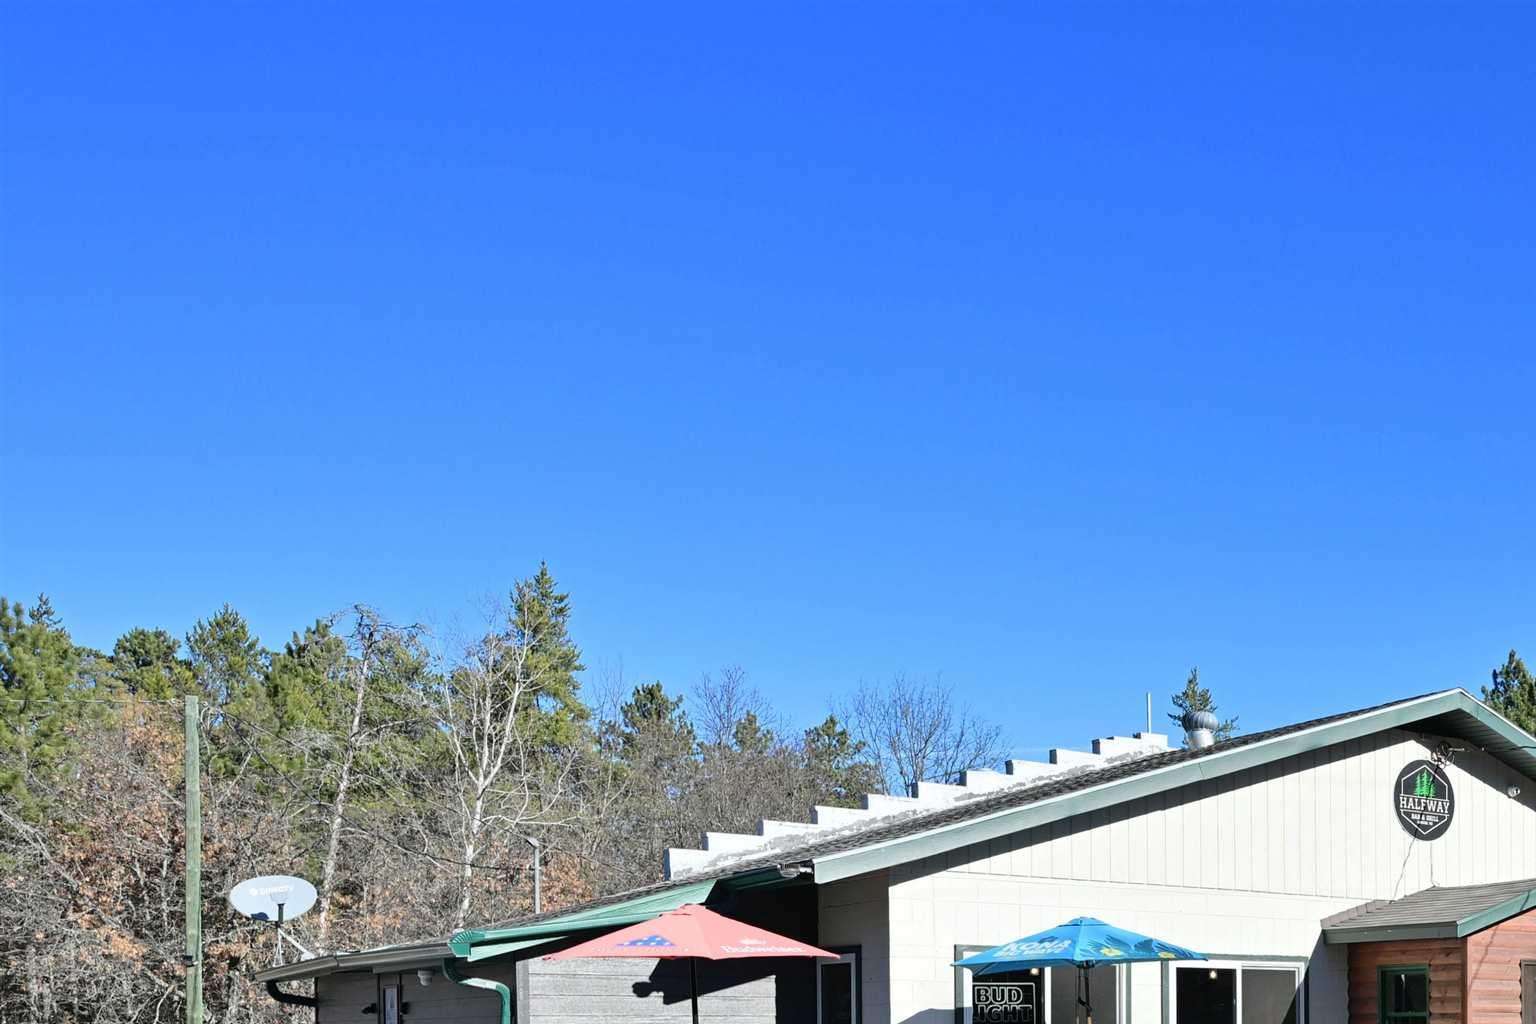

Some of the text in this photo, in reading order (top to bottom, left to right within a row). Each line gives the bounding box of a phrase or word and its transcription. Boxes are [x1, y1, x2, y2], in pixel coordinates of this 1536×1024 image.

[1400, 796, 1449, 813] HALFWAY
[975, 986, 1023, 1005] BUD
[973, 1004, 1033, 1023] IGHT
